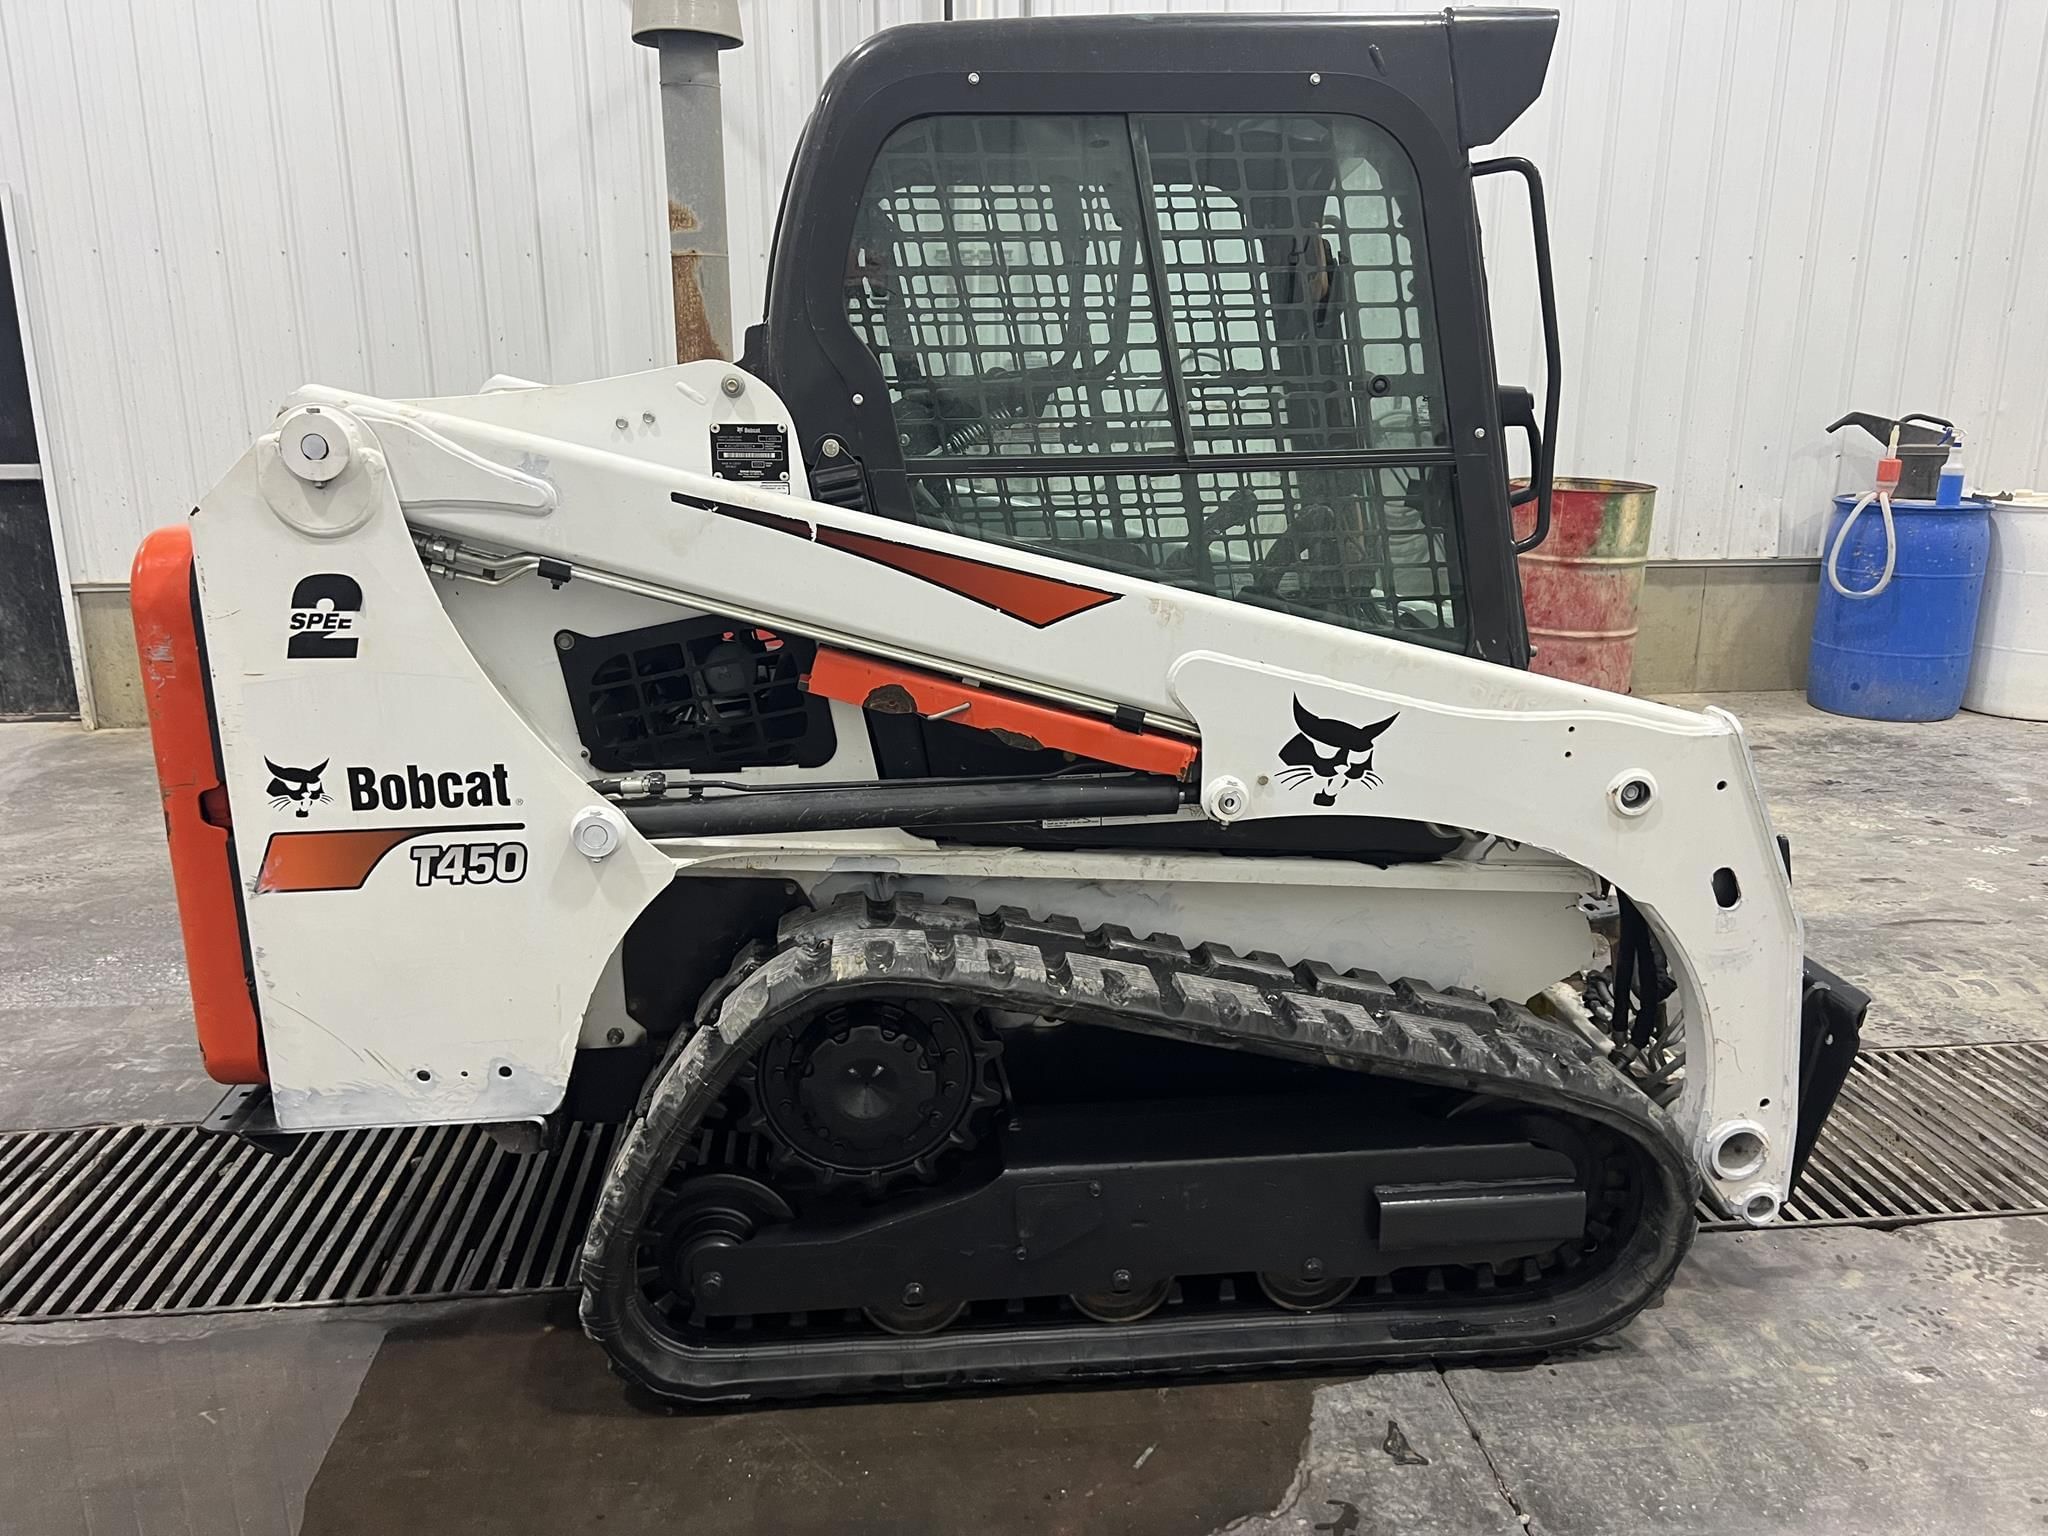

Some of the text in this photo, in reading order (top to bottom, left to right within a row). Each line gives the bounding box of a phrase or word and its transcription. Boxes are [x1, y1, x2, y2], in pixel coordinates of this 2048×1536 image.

[287, 573, 363, 659] 2
[346, 763, 511, 812] Bobcat
[409, 841, 528, 887] T450
